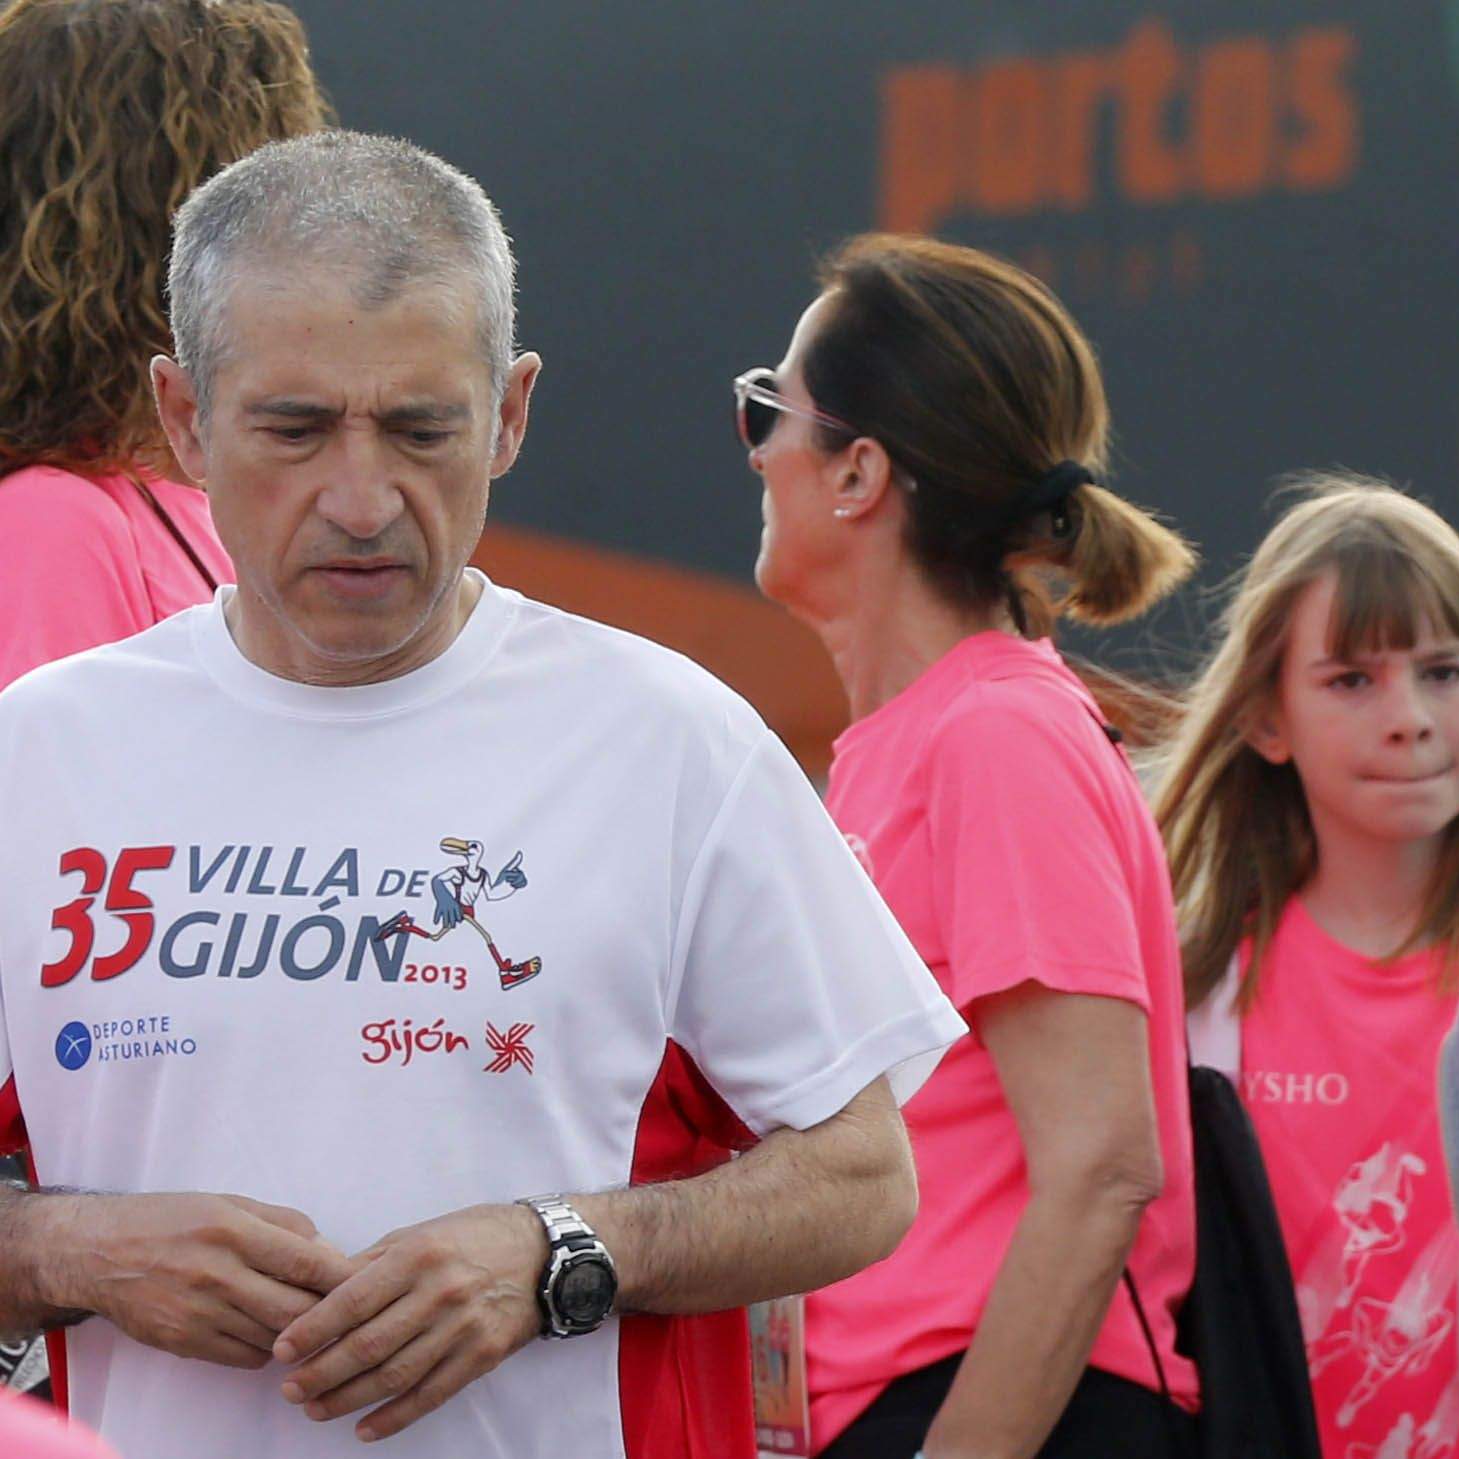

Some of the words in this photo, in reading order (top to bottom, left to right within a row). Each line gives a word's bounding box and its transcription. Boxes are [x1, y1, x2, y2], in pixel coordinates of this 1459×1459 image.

[40, 845, 175, 988] 35
[187, 845, 359, 898] VILLA
[376, 868, 428, 898] DE
[158, 895, 413, 982] GIJÓN
[403, 963, 468, 990] 2013
[93, 1016, 170, 1040] DEPORTE
[98, 1038, 197, 1062] ASTURIANO
[361, 1018, 469, 1067] gijón
